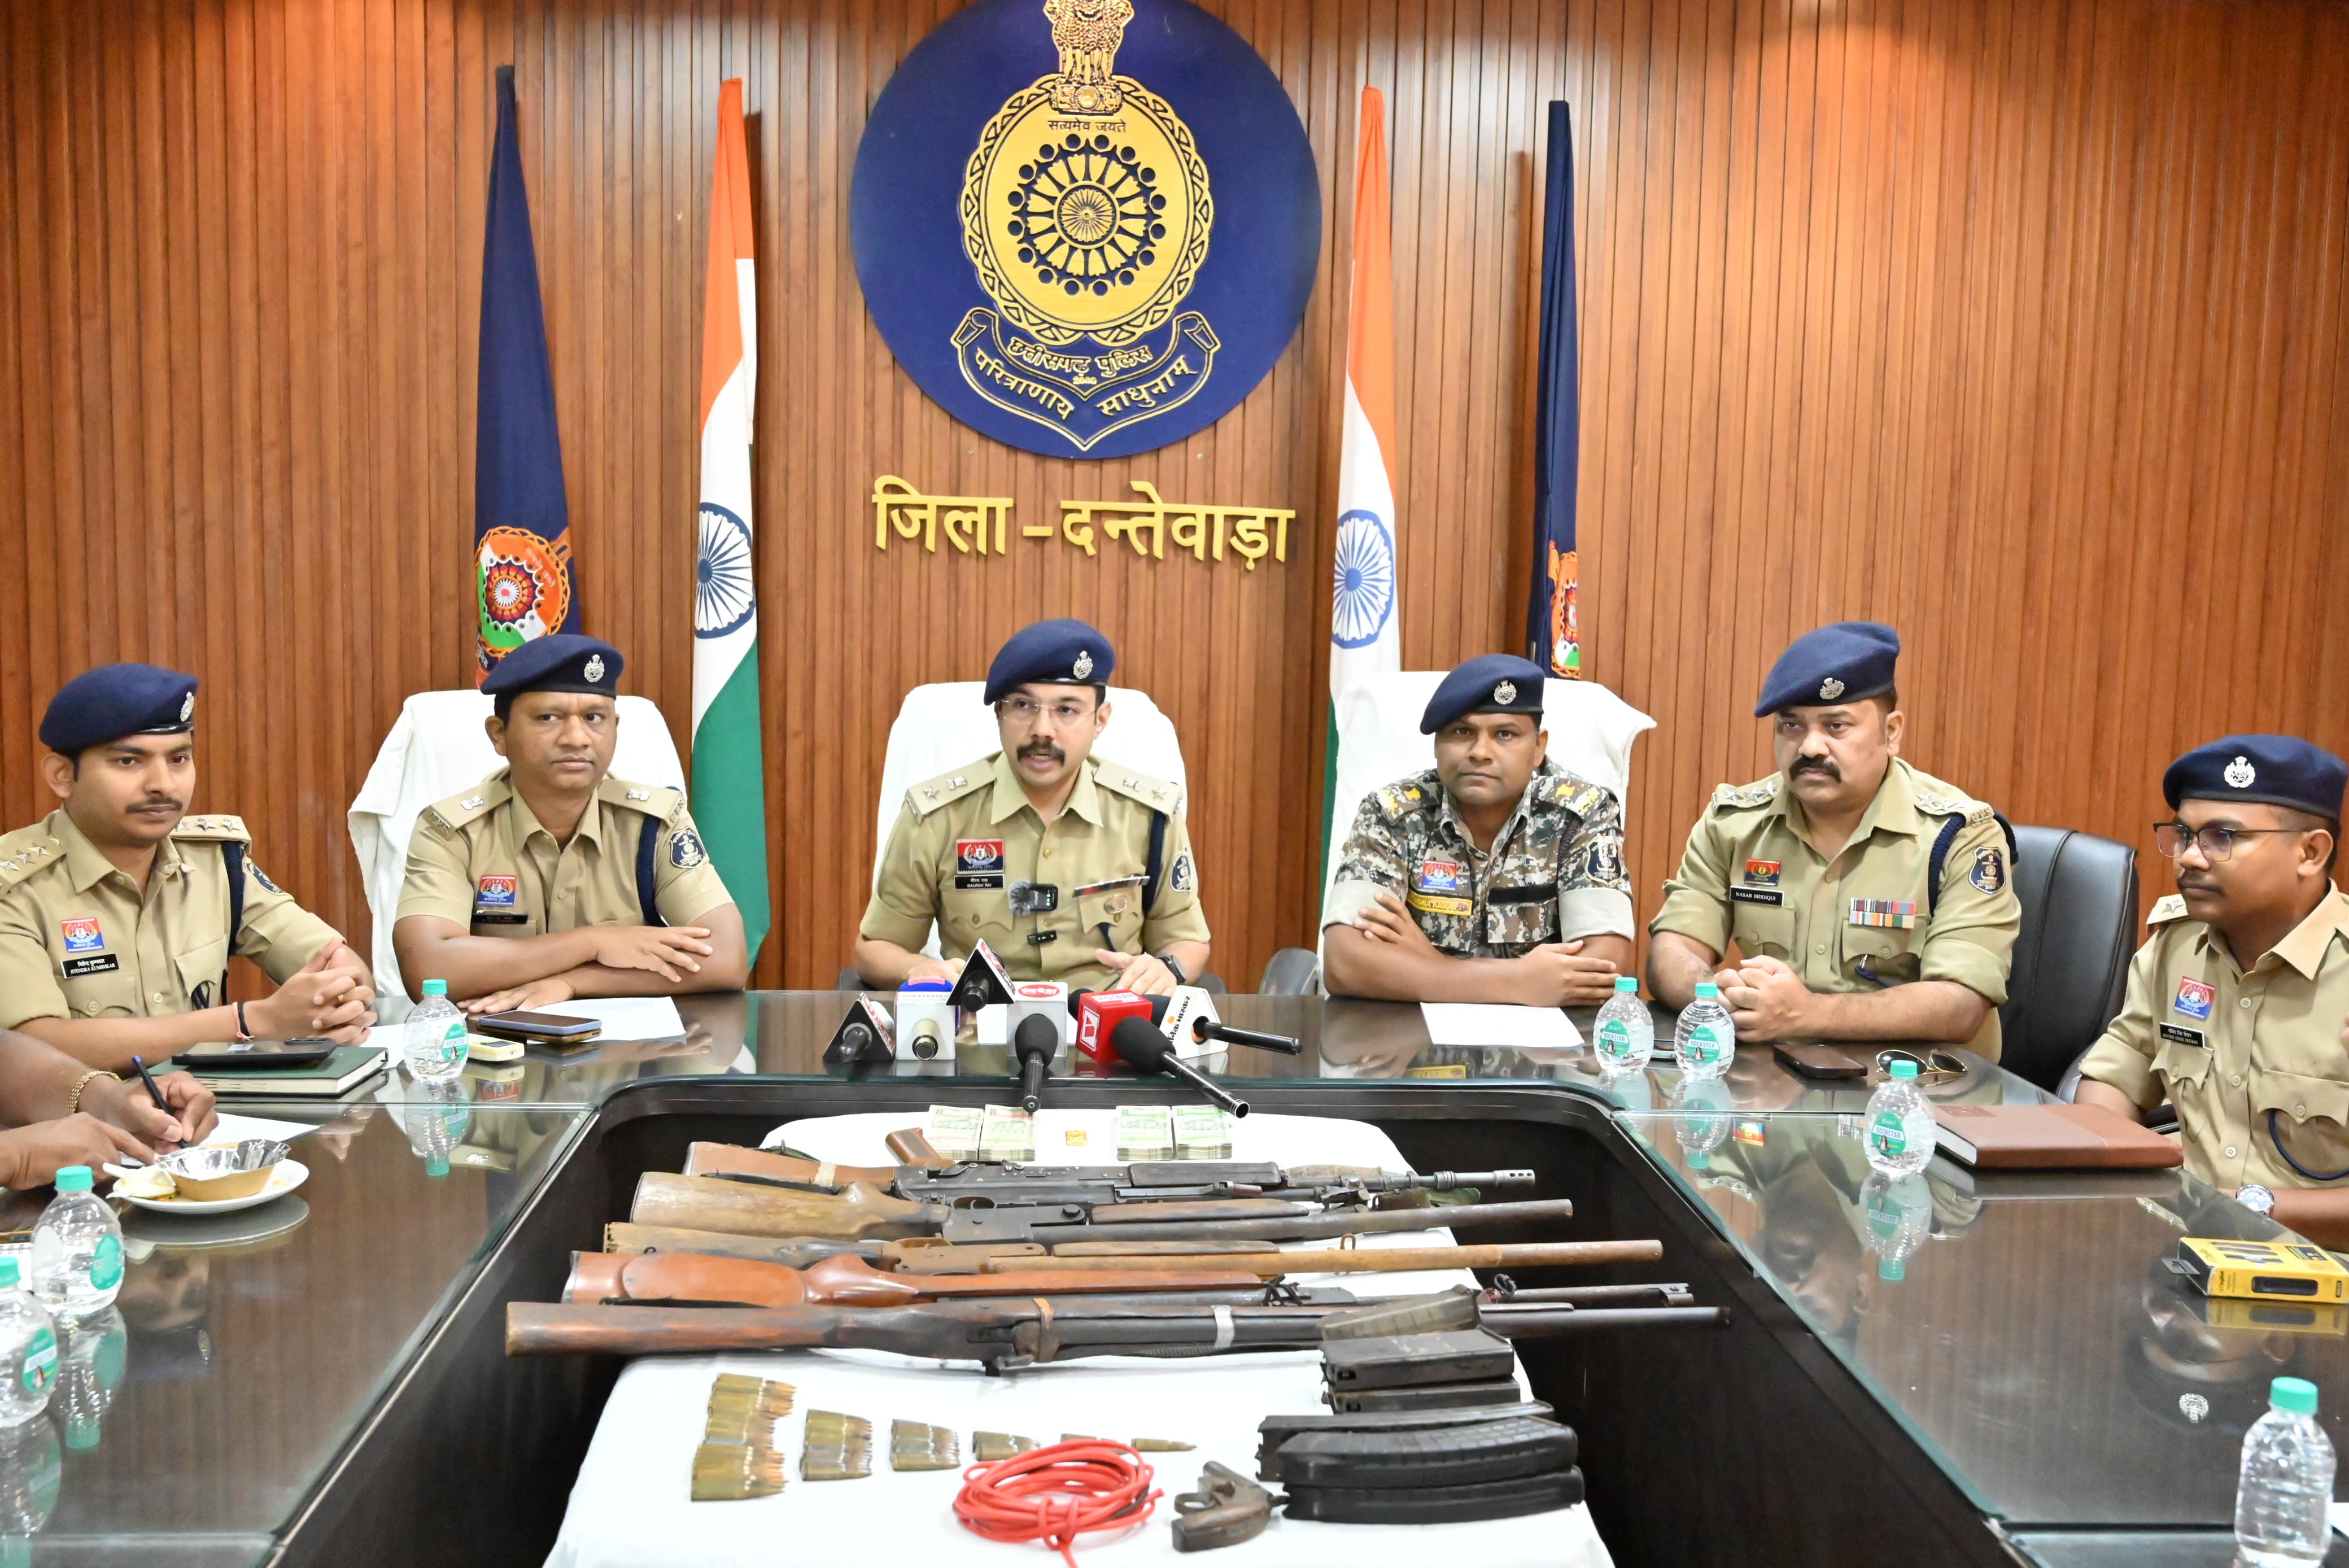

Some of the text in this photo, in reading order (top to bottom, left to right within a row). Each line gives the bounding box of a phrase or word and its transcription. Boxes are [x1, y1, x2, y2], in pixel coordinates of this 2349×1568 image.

[1047, 117, 1126, 132] सत्यमेव जयते
[1095, 345, 1153, 377] पुलिस
[975, 347, 1198, 420] परित्राणाय साधुनाम्
[872, 475, 1014, 556] जिला
[446, 1038, 465, 1047] ROCKSTAR
[1604, 1032, 1625, 1042] ROCKSTAR
[1691, 1040, 1715, 1049] ROCKSTAR
[1876, 1126, 1901, 1139] ROCKSTAR
